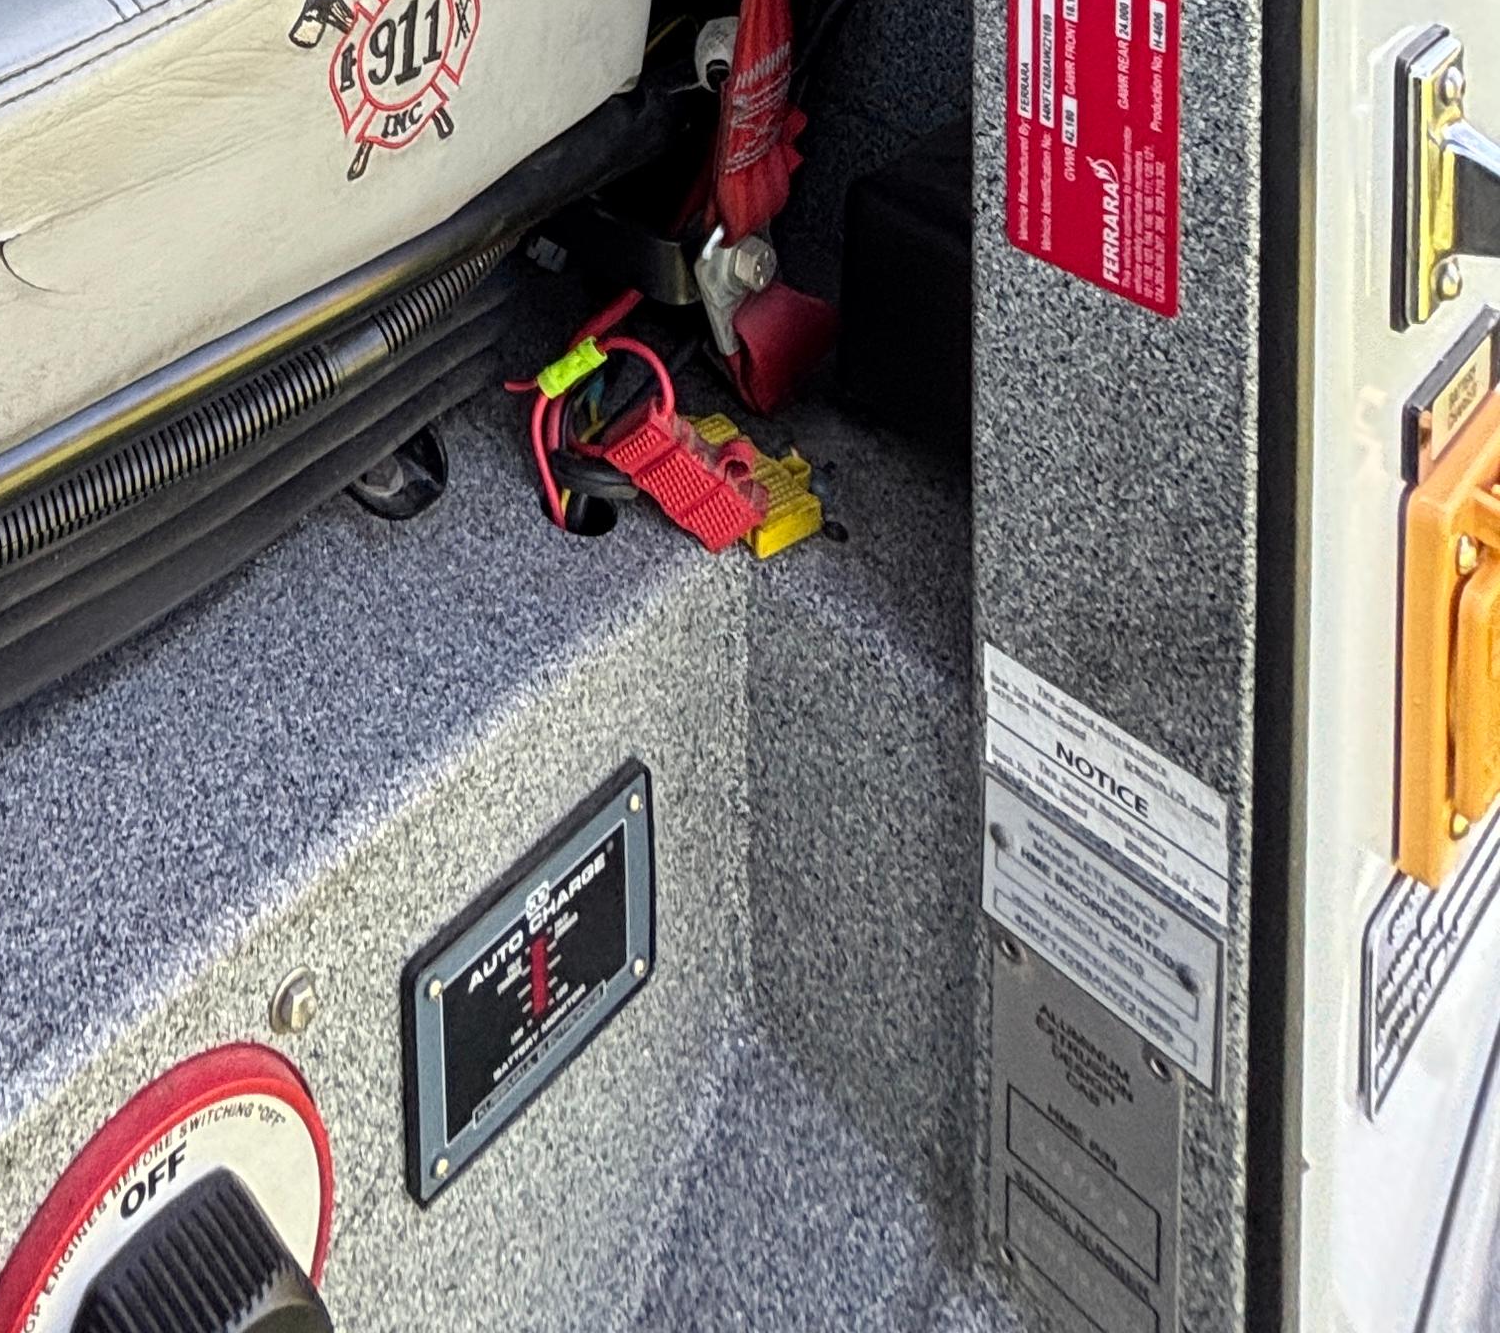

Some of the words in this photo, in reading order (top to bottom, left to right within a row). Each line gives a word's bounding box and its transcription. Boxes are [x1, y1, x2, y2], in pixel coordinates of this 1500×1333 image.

[1065, 23, 1076, 59] FRONT
[1118, 41, 1129, 74] REAR
[1021, 62, 1030, 112] FERRARA
[1065, 61, 1076, 95] GAWR
[1118, 75, 1129, 109] GAWR
[1150, 77, 1164, 132] Production
[381, 101, 424, 138] INC
[1019, 138, 1029, 203] Manufactured
[1041, 153, 1052, 214] Identification
[1065, 148, 1076, 181] GVWR
[1019, 206, 1029, 240] Vehicle
[1041, 217, 1051, 251] Vehicle
[1103, 182, 1119, 284] FERRARA
[1056, 740, 1148, 819] NOTICE
[529, 851, 606, 935] CHARGE
[1027, 819, 1107, 888] INCOMPLETE
[1112, 881, 1168, 932] VEHICLE
[1032, 839, 1139, 928] MANUFACTURED
[1142, 920, 1159, 943] BY
[1020, 846, 1050, 878] HME
[1055, 871, 1175, 973] INCORPORATED
[468, 930, 523, 993] AUTO
[1108, 940, 1143, 979] 2010
[493, 1028, 539, 1082] BATTERY
[541, 983, 586, 1033] MONITOR
[1036, 1013, 1133, 1104] EXTRUSION
[1039, 1001, 1130, 1086] ALUMINUM
[1066, 1069, 1099, 1108] CAB
[179, 1101, 253, 1137] SWITCHING
[120, 1142, 188, 1220] OFF
